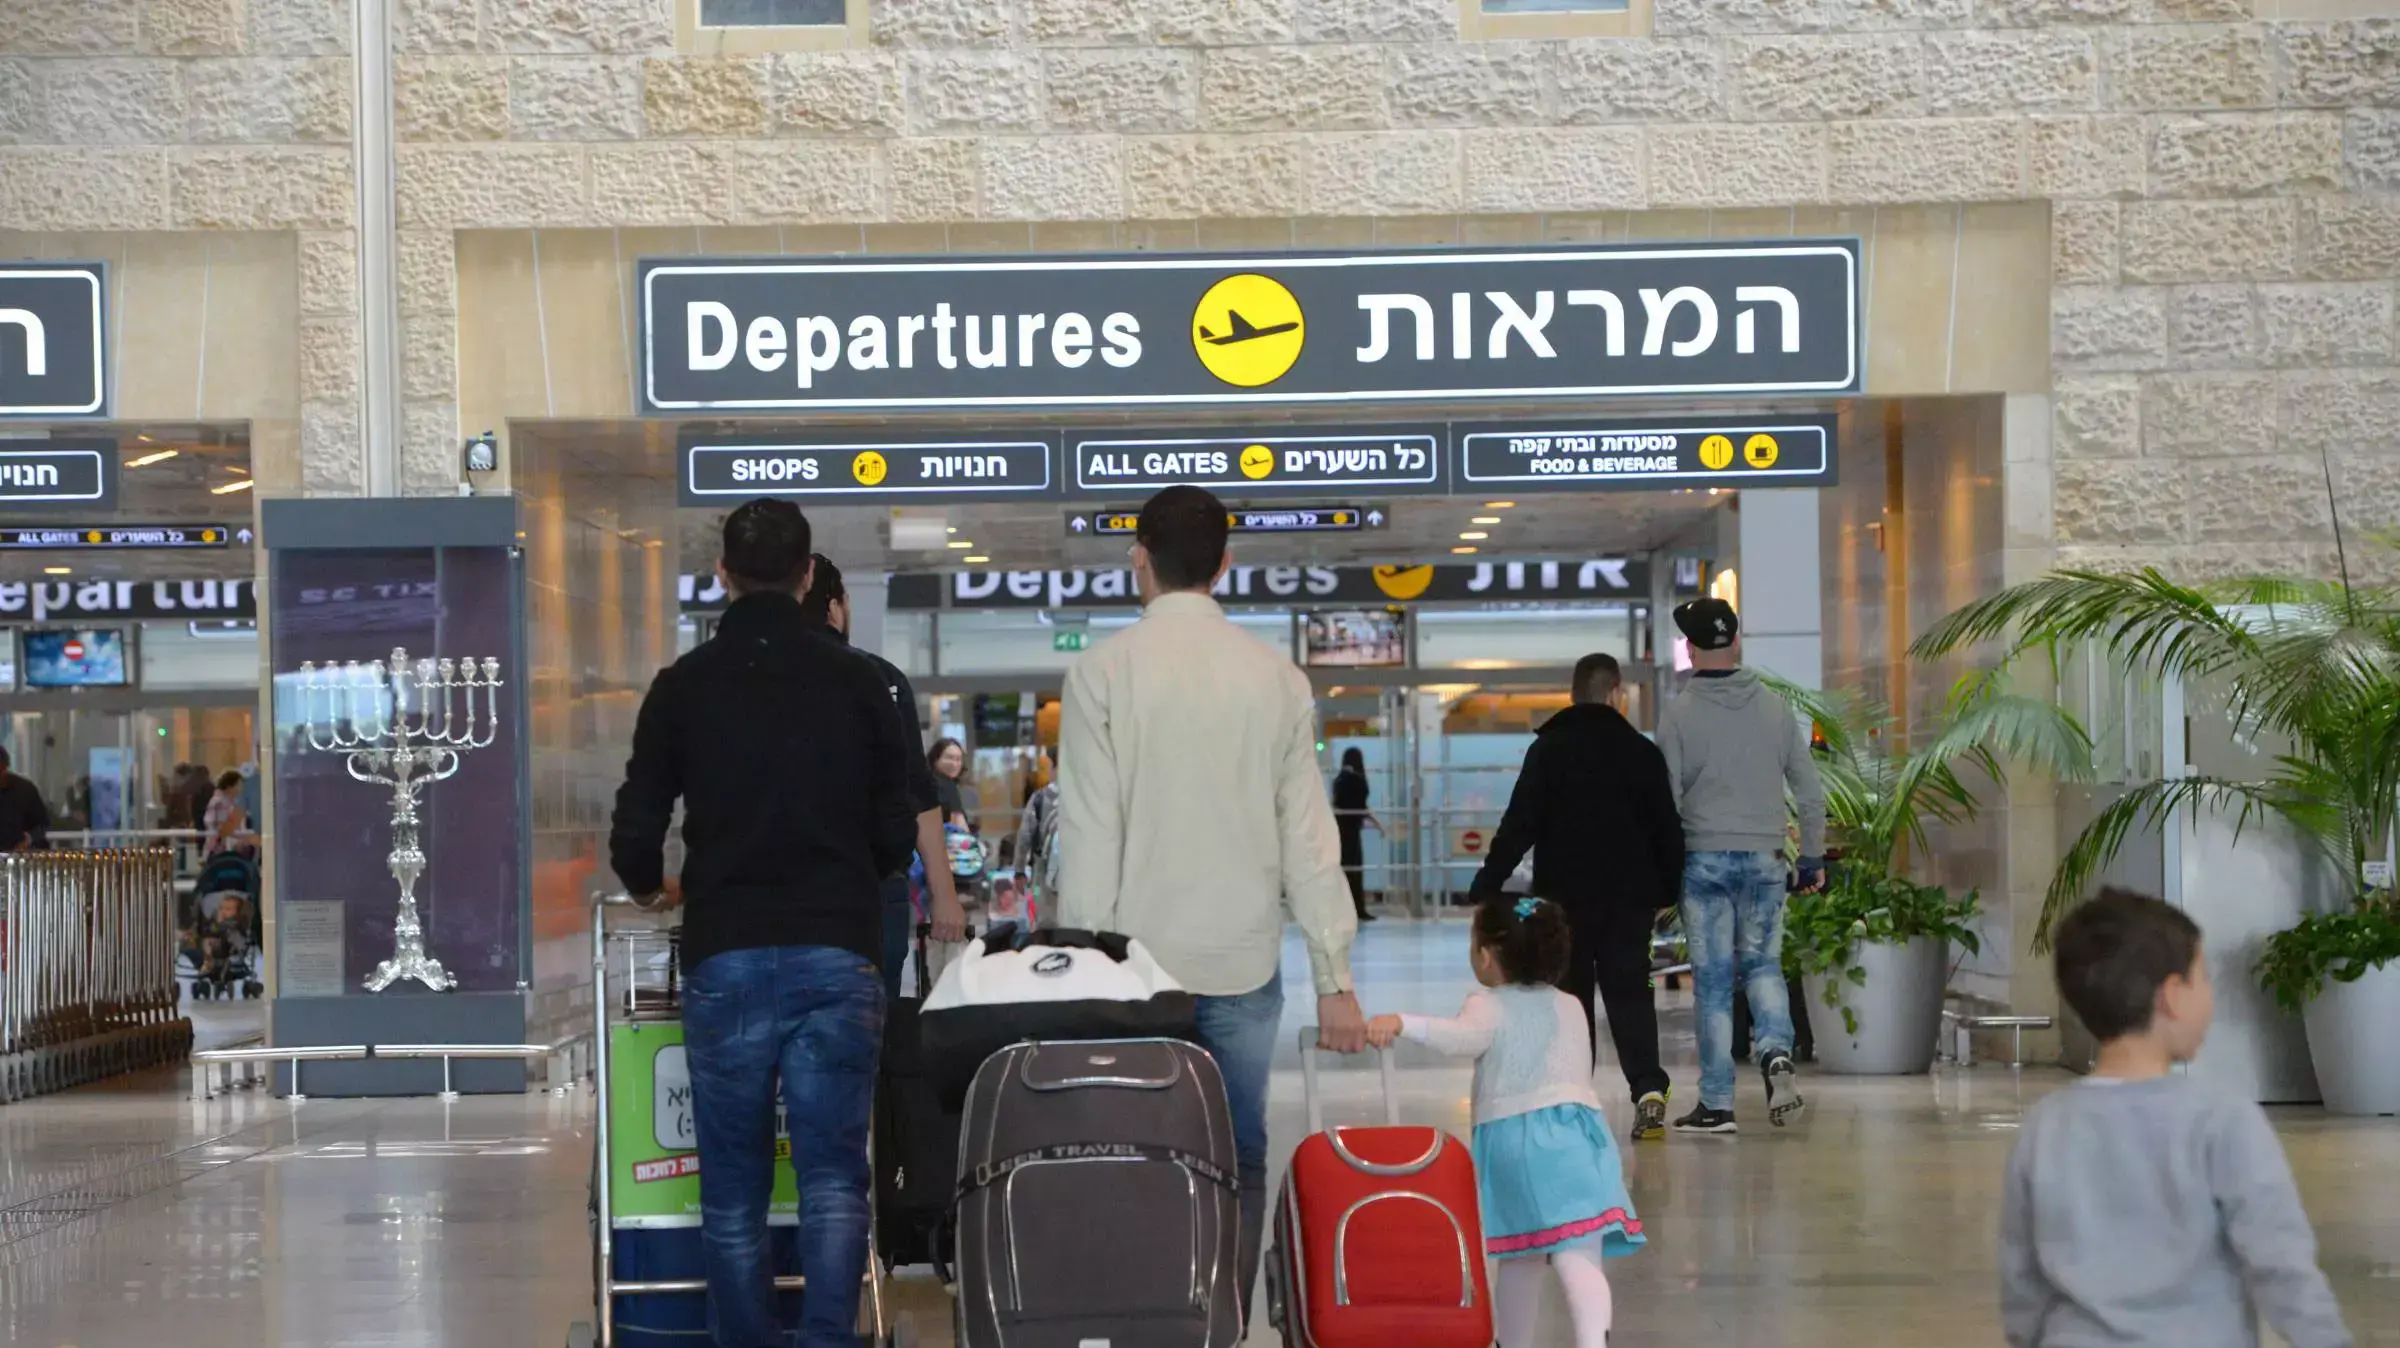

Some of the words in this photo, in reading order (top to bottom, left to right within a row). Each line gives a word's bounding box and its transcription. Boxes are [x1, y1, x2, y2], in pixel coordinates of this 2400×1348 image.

[1357, 286, 1801, 362] המראות
[687, 301, 1142, 388] Departures
[1509, 437, 1550, 457] קפה
[1556, 436, 1596, 453] ובתי
[1601, 435, 1678, 453] מסעדות
[920, 456, 1008, 479] חנויות
[1088, 454, 1138, 476] ALL
[1143, 451, 1229, 475] GATES
[1284, 448, 1387, 473] השערים
[1394, 443, 1426, 471] כל
[1530, 458, 1575, 474] FOOD
[1578, 458, 1590, 474] &
[1593, 456, 1679, 473] BEVERAGE
[0, 464, 59, 487] חנוי
[731, 457, 820, 481] SHOPS
[18, 531, 40, 544] ALL
[1052, 1143, 1144, 1157] TRAVEL
